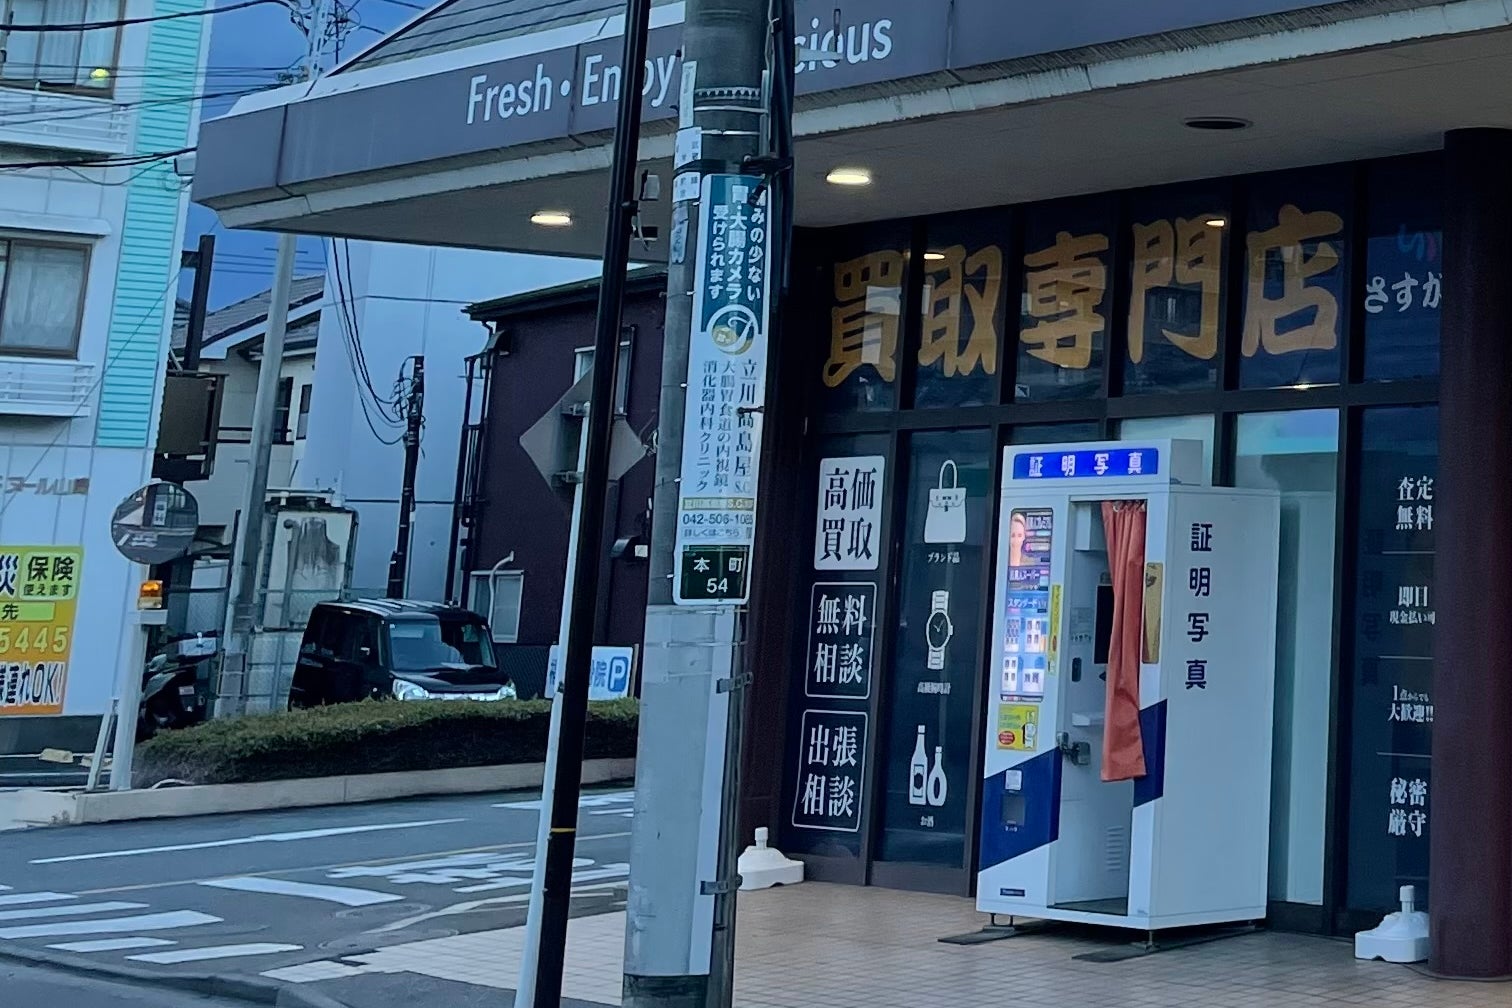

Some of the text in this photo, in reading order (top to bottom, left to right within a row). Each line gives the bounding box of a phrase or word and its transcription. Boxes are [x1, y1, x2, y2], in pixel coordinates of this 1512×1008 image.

[709, 204, 729, 300] 受けられます
[822, 203, 1343, 387] 買取専門店
[1028, 451, 1143, 477] 証明写真
[824, 467, 878, 511] 高価
[1397, 475, 1434, 501] 査定
[1395, 504, 1434, 530] 無料
[819, 516, 873, 562] 買取
[27, 556, 74, 582] 保険
[693, 556, 743, 573] 本町
[706, 577, 729, 593] 54
[1398, 586, 1428, 607] 即日
[816, 593, 867, 637] 無料
[1185, 521, 1213, 691] 証明写真
[609, 659, 626, 690] P
[813, 642, 863, 684] 相談
[808, 723, 858, 767] 出張
[801, 774, 853, 818] 相談
[1389, 777, 1427, 807] 秘密
[1388, 808, 1426, 837] 厳守
